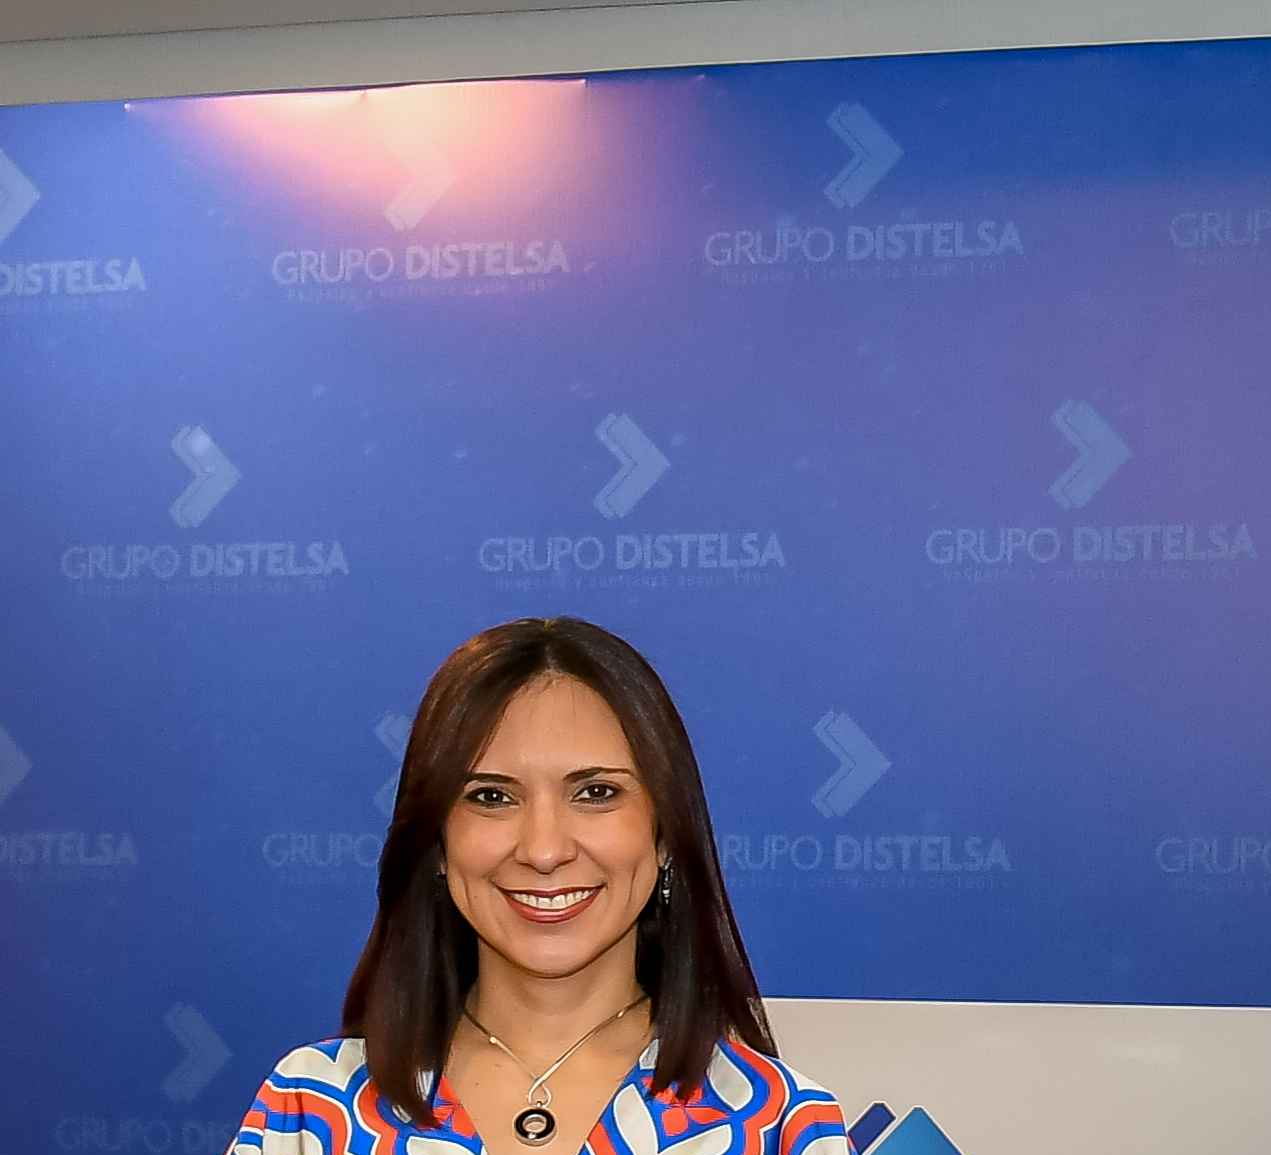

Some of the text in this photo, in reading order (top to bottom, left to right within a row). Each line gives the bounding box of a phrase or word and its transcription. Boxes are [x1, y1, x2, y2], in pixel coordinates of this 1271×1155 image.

[272, 240, 570, 285] GRUPO DISTELSA
[704, 220, 1024, 266] GRUPO DISTELSA
[60, 540, 350, 580] GRUPO DISTELSA
[478, 532, 787, 573] GRUPO DISTELSA
[925, 523, 1259, 565] GRUPO DISTELSA
[717, 834, 1011, 872] RUPO DISTELSA
